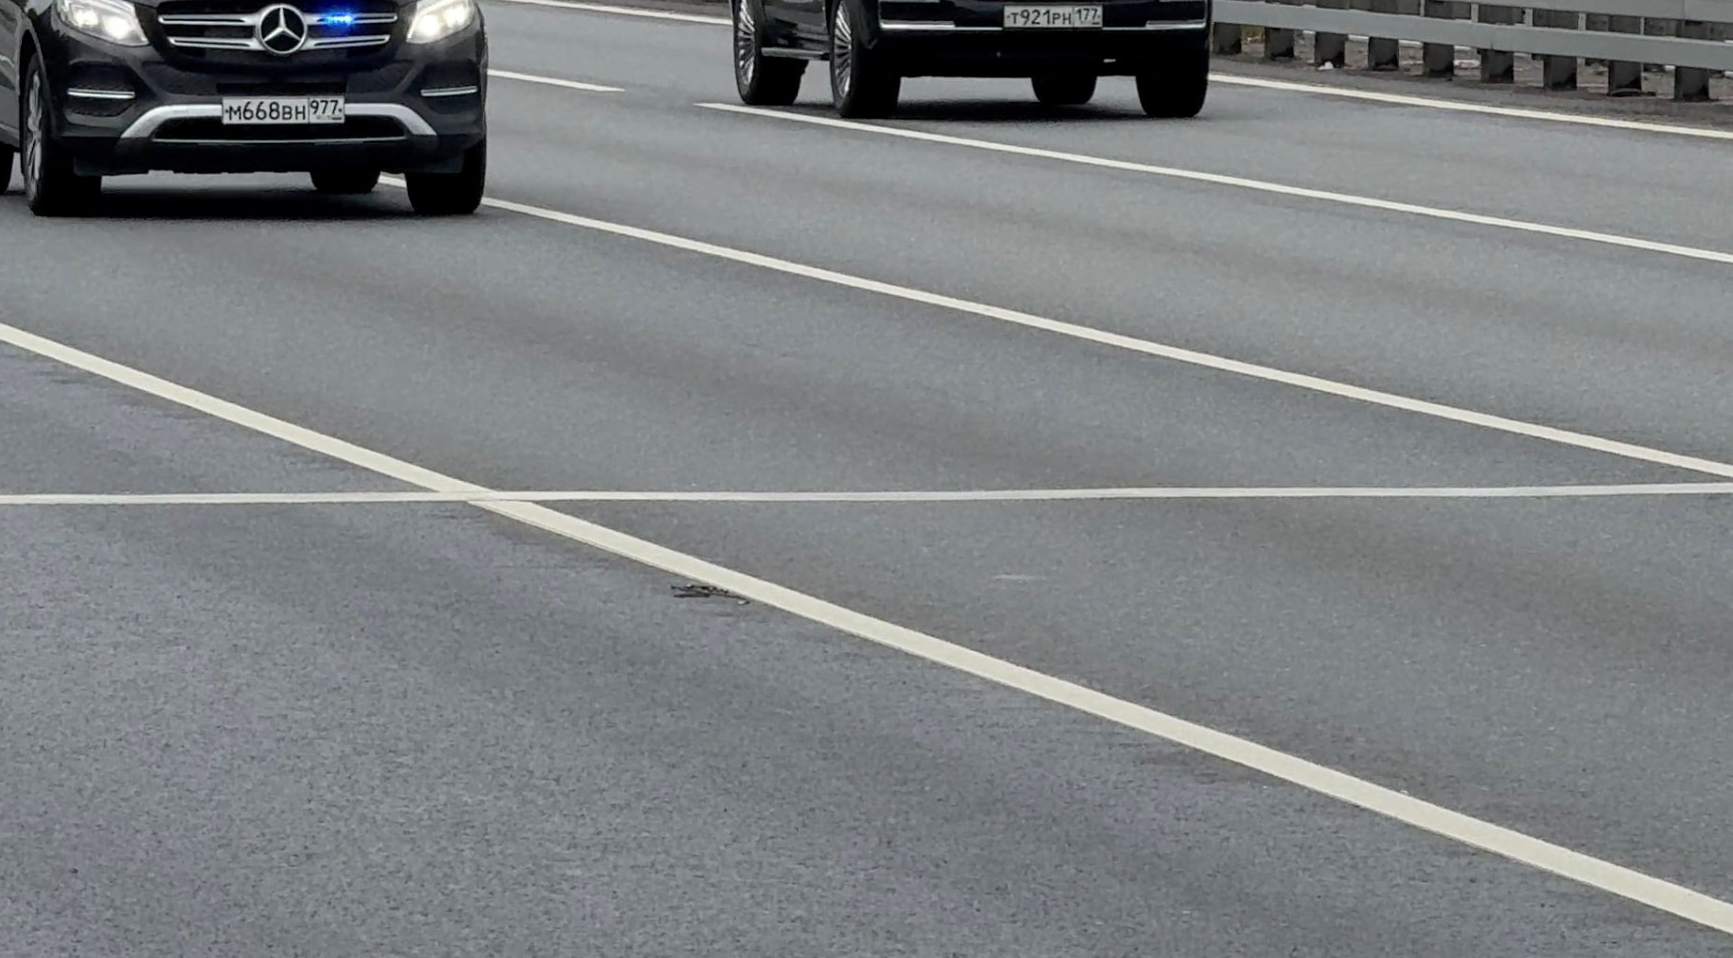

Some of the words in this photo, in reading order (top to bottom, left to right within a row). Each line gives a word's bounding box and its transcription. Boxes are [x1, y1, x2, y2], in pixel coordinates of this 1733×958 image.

[1010, 8, 1072, 25] Т921РН
[1076, 8, 1098, 21] 177
[228, 101, 306, 121] М668ВН
[310, 100, 339, 115] 977
